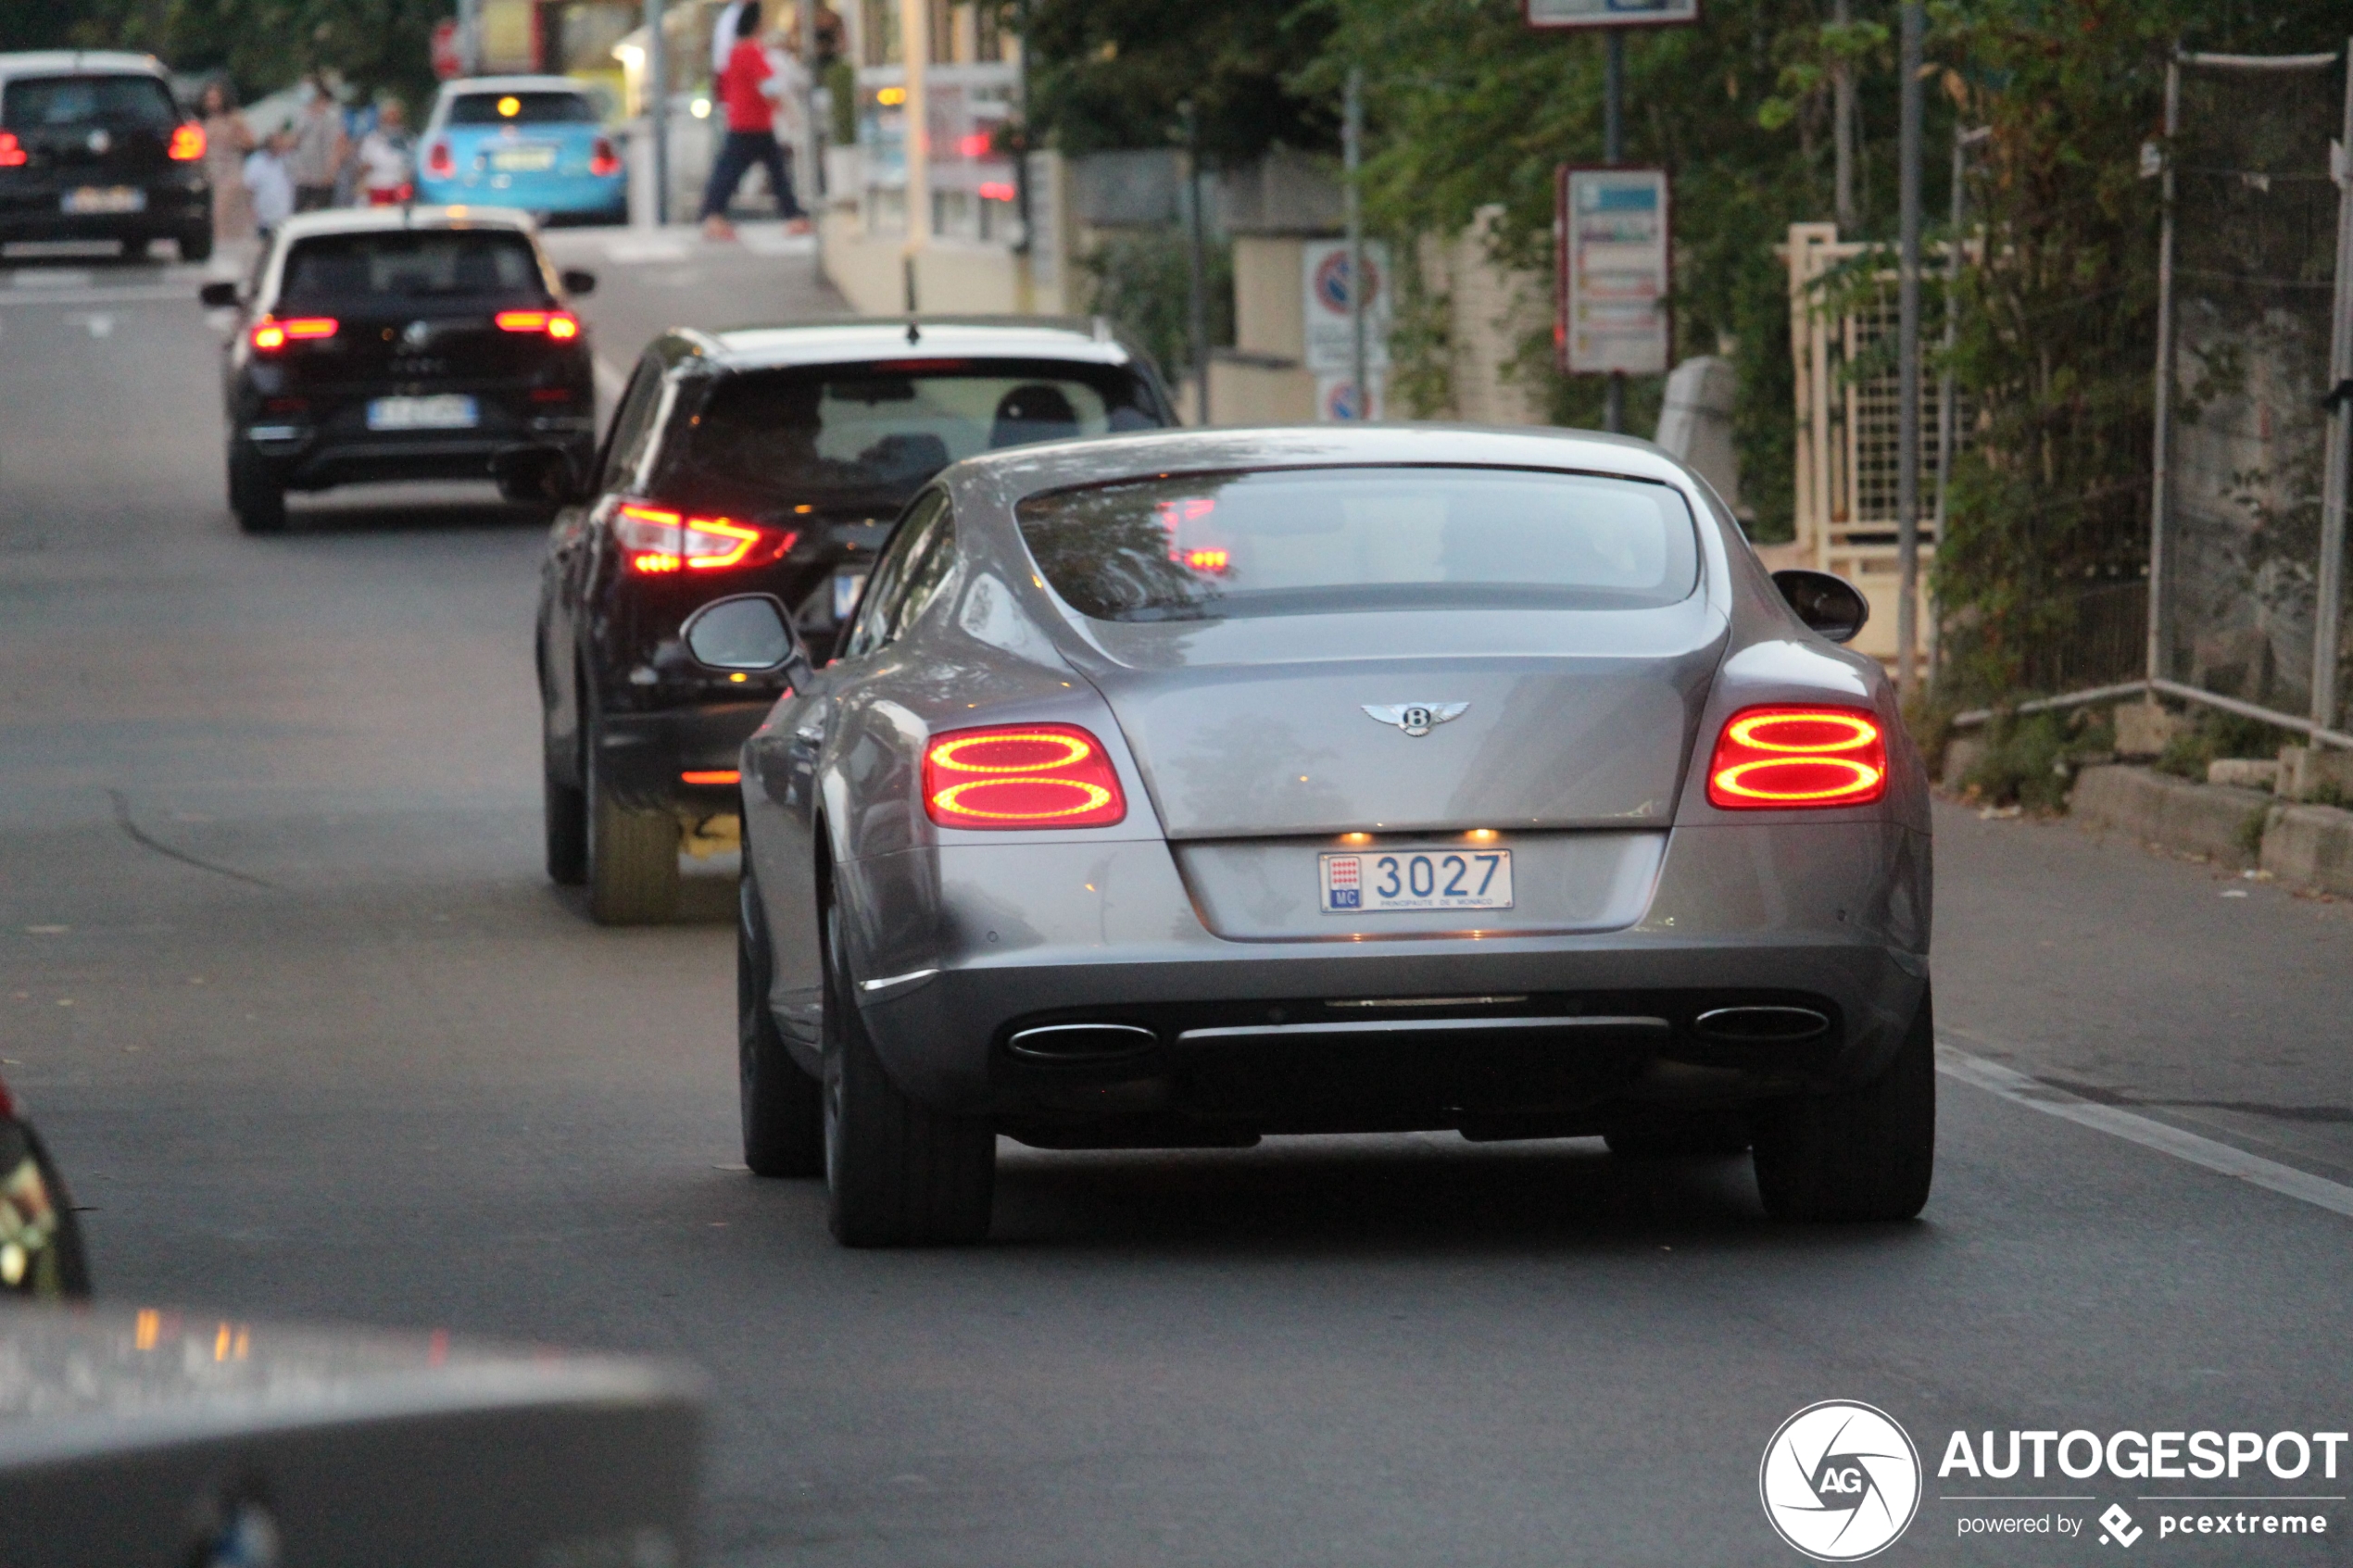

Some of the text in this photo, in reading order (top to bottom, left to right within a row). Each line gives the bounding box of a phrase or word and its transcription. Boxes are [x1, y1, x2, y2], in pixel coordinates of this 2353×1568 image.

[1407, 708, 1428, 727] B
[1377, 855, 1500, 898] 3027
[1336, 890, 1356, 905] MC
[1457, 897, 1493, 906] MONACO
